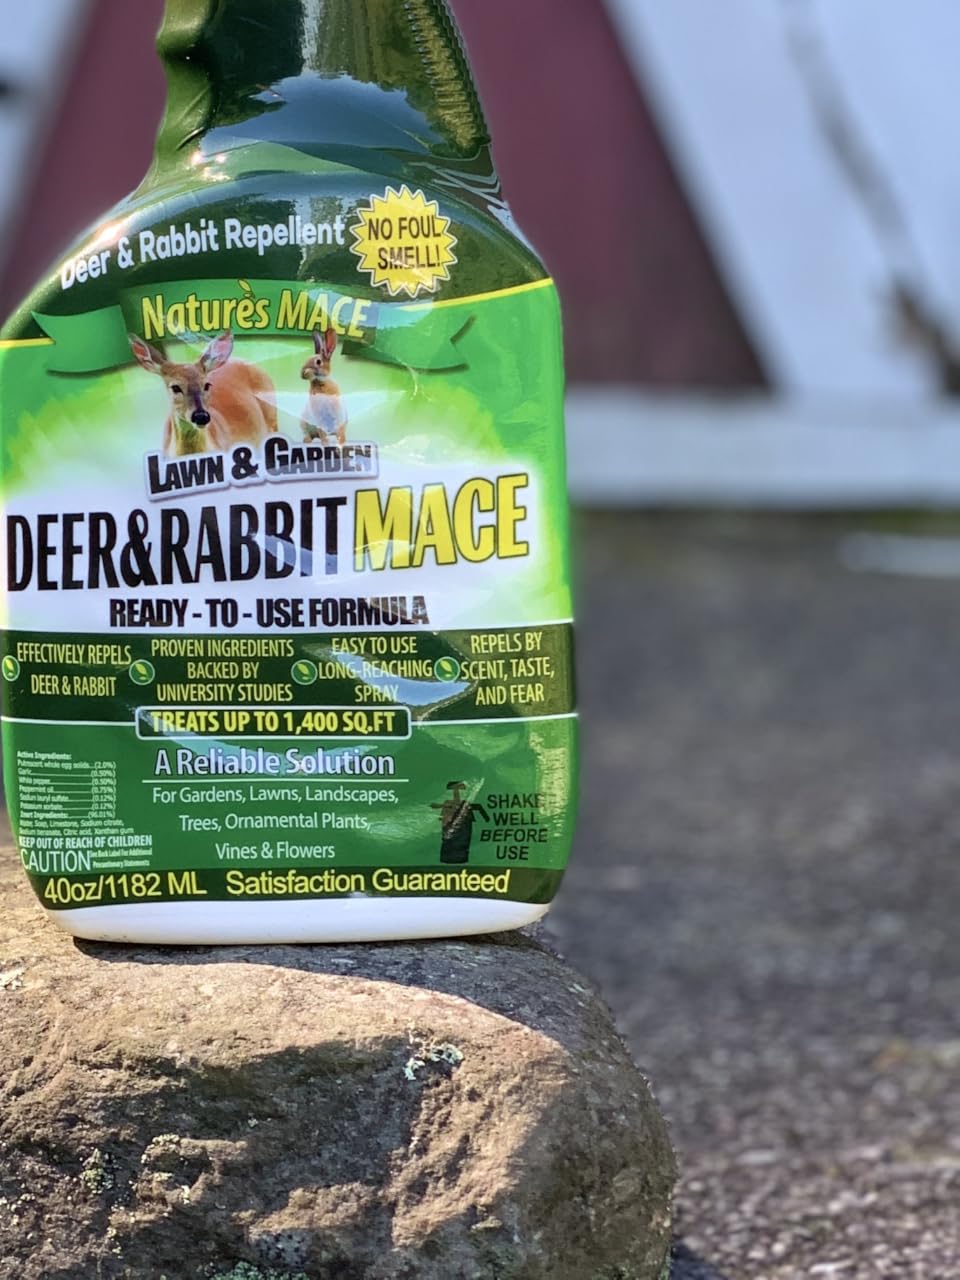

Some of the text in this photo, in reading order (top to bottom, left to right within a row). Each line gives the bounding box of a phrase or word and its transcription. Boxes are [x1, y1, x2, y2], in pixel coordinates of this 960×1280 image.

[368, 216, 441, 241] NO FOUL
[61, 216, 345, 290] Deer & Rabbit Repellent
[377, 245, 441, 270] SMELL!
[277, 290, 371, 338] MACE
[231, 445, 258, 479] &
[353, 472, 529, 572] MACE
[310, 595, 429, 626] FORMULA
[17, 641, 132, 665] EFFECTIVELY REPELS
[151, 638, 295, 657] PROVEN INGREDIENTS
[331, 636, 417, 655] EASY TO USE
[470, 631, 543, 654] REPELS BY
[187, 662, 260, 679] BACKED BY
[318, 659, 433, 680] LONG-REACHING
[461, 657, 555, 681] SCENT, TASTE,
[31, 674, 117, 697] DEER & RABBIT
[157, 683, 293, 702] UNIVERSITY STUDIES
[354, 684, 399, 703] SPRAY
[475, 683, 544, 705] AND FEAR
[151, 710, 396, 735] TREATS UP TO 1,400 SQ.FT
[154, 747, 395, 776] A Reliable Solution
[153, 785, 399, 805] For Gardens, Lawns, Landscapes,
[487, 793, 545, 809] SHAKE
[179, 812, 371, 833] Trees, Ornamental Plants,
[493, 812, 539, 826] WELL
[19, 835, 152, 849] KEEP OUT OF REACH OF CHILDREN
[480, 828, 548, 843] BEFORE
[20, 848, 91, 873] CAUTION
[215, 840, 336, 860] Vines & Flowers
[496, 846, 529, 861] USE
[44, 871, 208, 904] 40oz/1182 ML
[225, 868, 511, 896] Satisfaction Guaranteed
